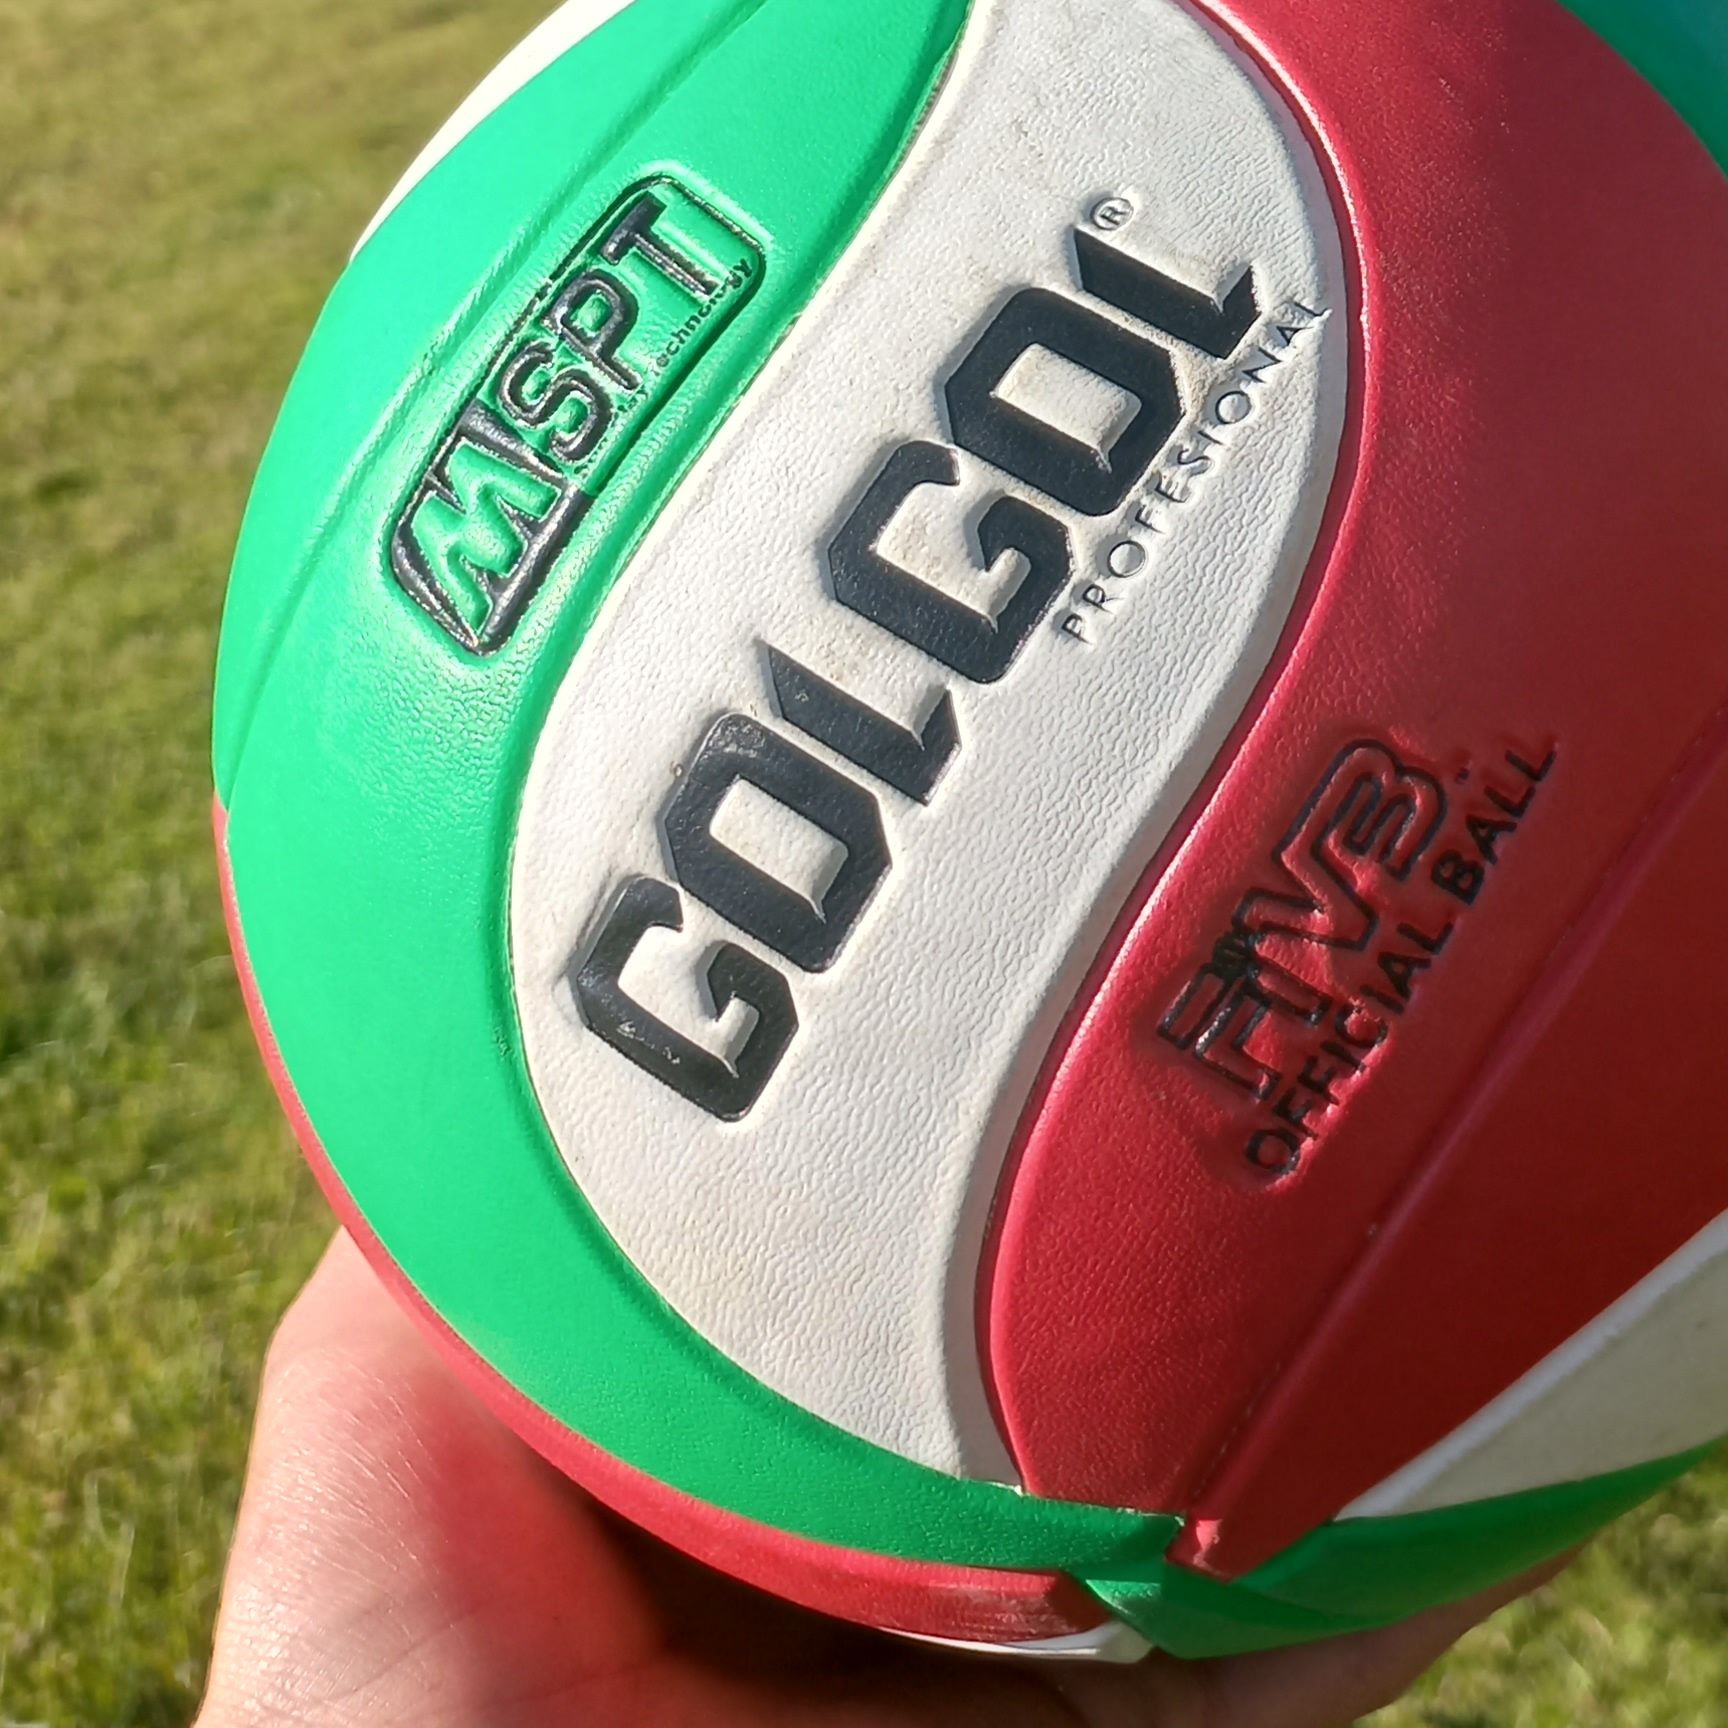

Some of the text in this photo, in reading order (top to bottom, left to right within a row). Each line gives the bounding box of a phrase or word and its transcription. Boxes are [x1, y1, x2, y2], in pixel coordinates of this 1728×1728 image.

[575, 227, 1262, 1123] GOLGOL
[1060, 300, 1330, 645] PROFESIONAL
[1243, 749, 1558, 1175] OFFICIAL BALL
